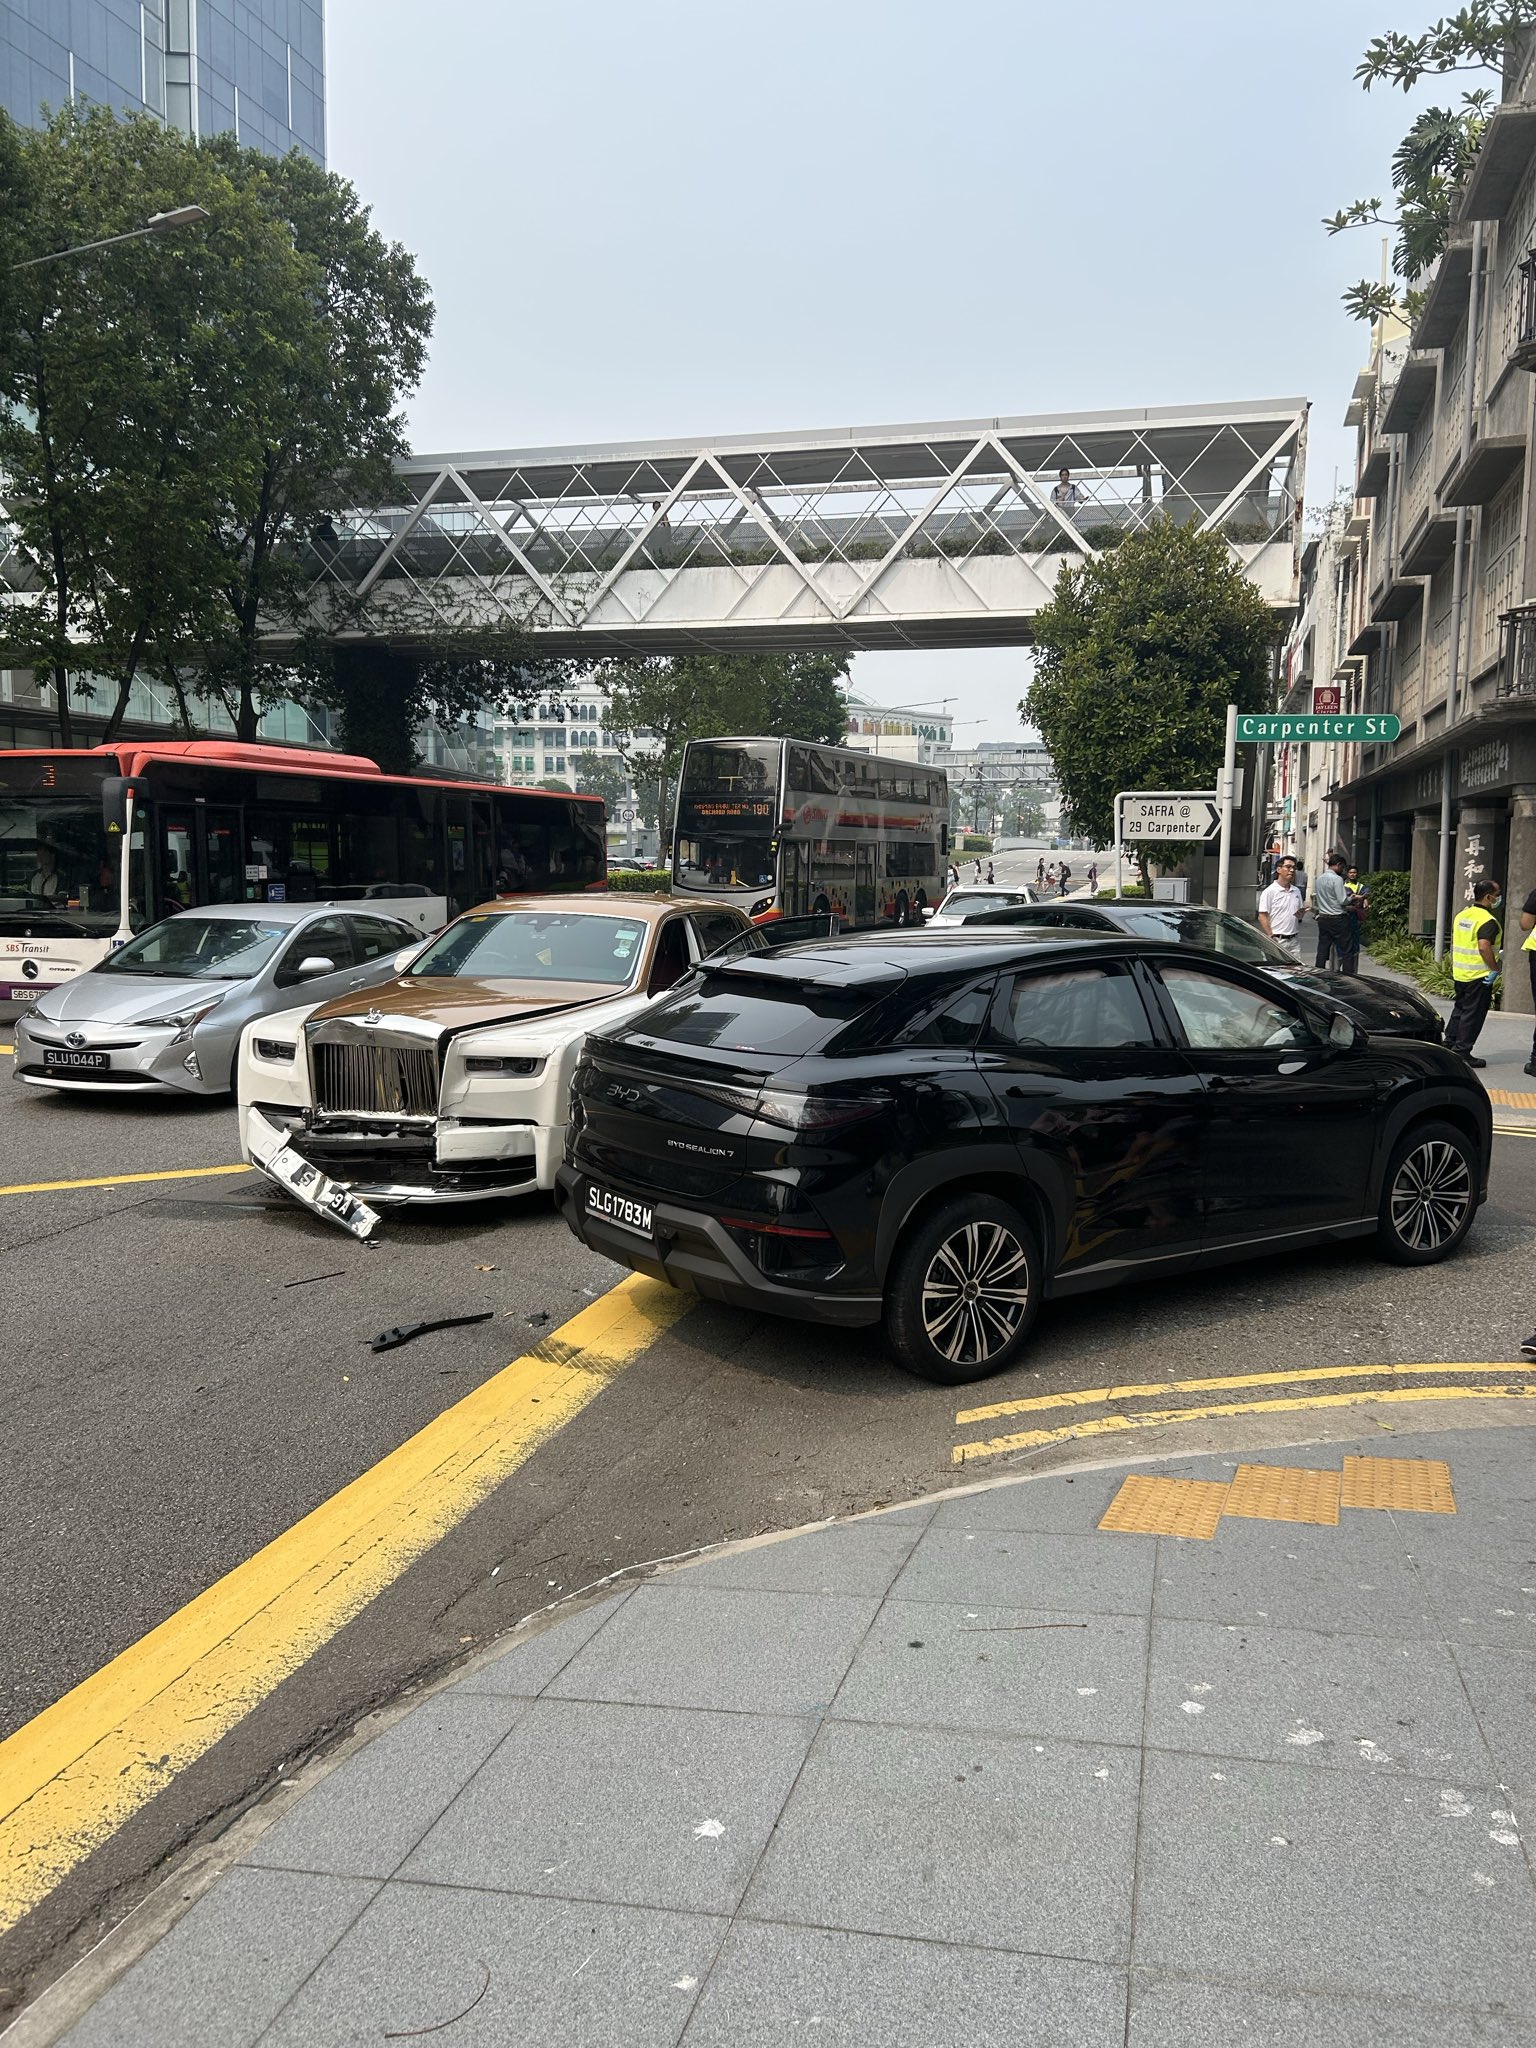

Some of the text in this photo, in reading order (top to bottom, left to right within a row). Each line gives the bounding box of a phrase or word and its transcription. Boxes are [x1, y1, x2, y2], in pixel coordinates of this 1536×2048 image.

[1242, 718, 1387, 739] Carpenter St
[752, 803, 769, 815] 190
[1140, 805, 1191, 818] SAFRA @
[1129, 821, 1201, 836] 29 Carpenter
[5, 942, 50, 953] SBS Transit
[47, 1052, 103, 1066] SLU1044P
[606, 1083, 640, 1102] BYD
[667, 1139, 685, 1149] BYD
[685, 1143, 726, 1156] SEALION
[331, 1193, 353, 1215] 9A
[589, 1186, 652, 1230] SLG1783M
